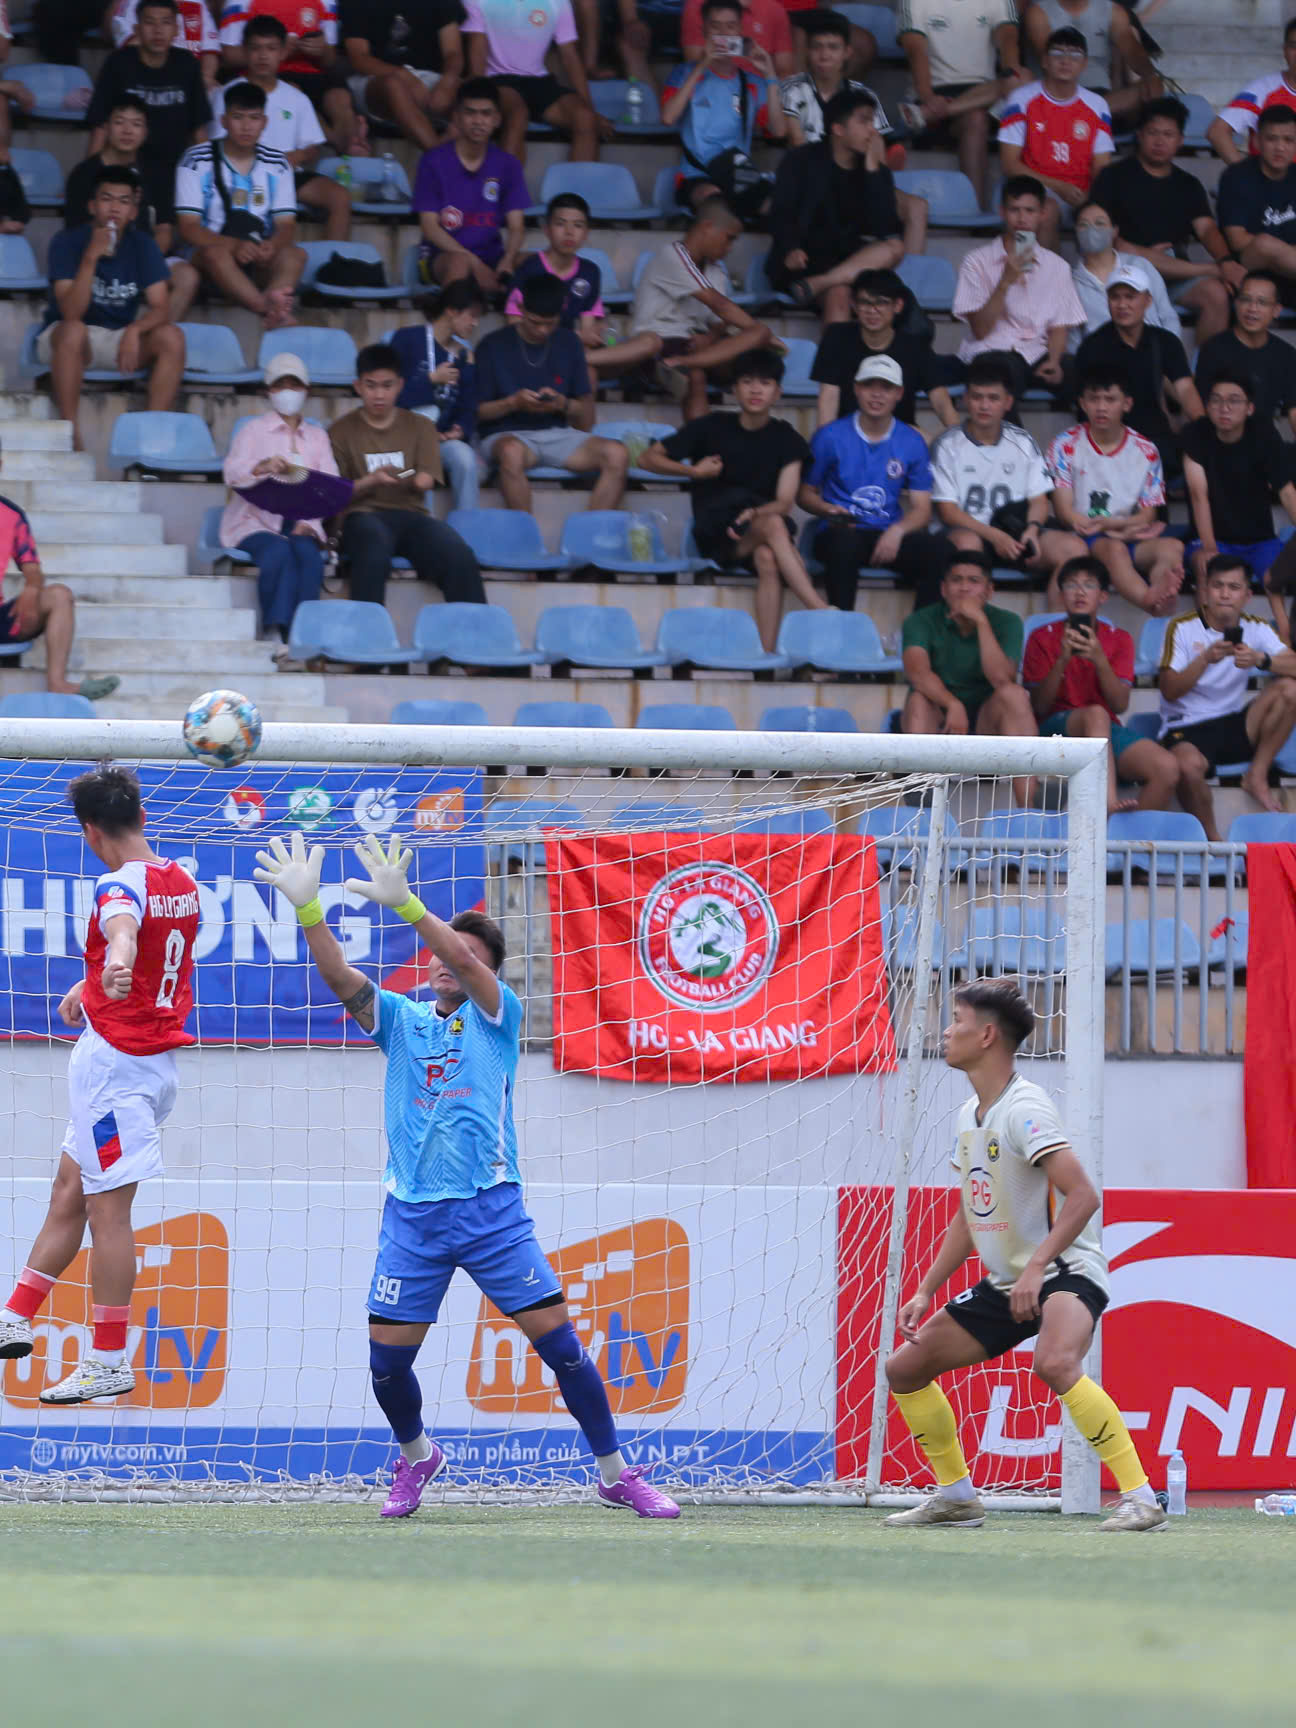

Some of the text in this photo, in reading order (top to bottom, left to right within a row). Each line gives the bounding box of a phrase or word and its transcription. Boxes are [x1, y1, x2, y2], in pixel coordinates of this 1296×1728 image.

[709, 875, 762, 920] GIANG
[155, 928, 186, 1009] 8
[654, 956, 728, 998] FOOTBALL
[729, 1019, 818, 1051] GIANG
[442, 1087, 473, 1099] PAPER
[970, 1179, 992, 1207] PG
[374, 1274, 402, 1306] 99
[480, 1311, 682, 1409] mtv
[60, 1445, 188, 1467] mytv.com.vn
[443, 1438, 710, 1468] Sản phẩm của VNPT
